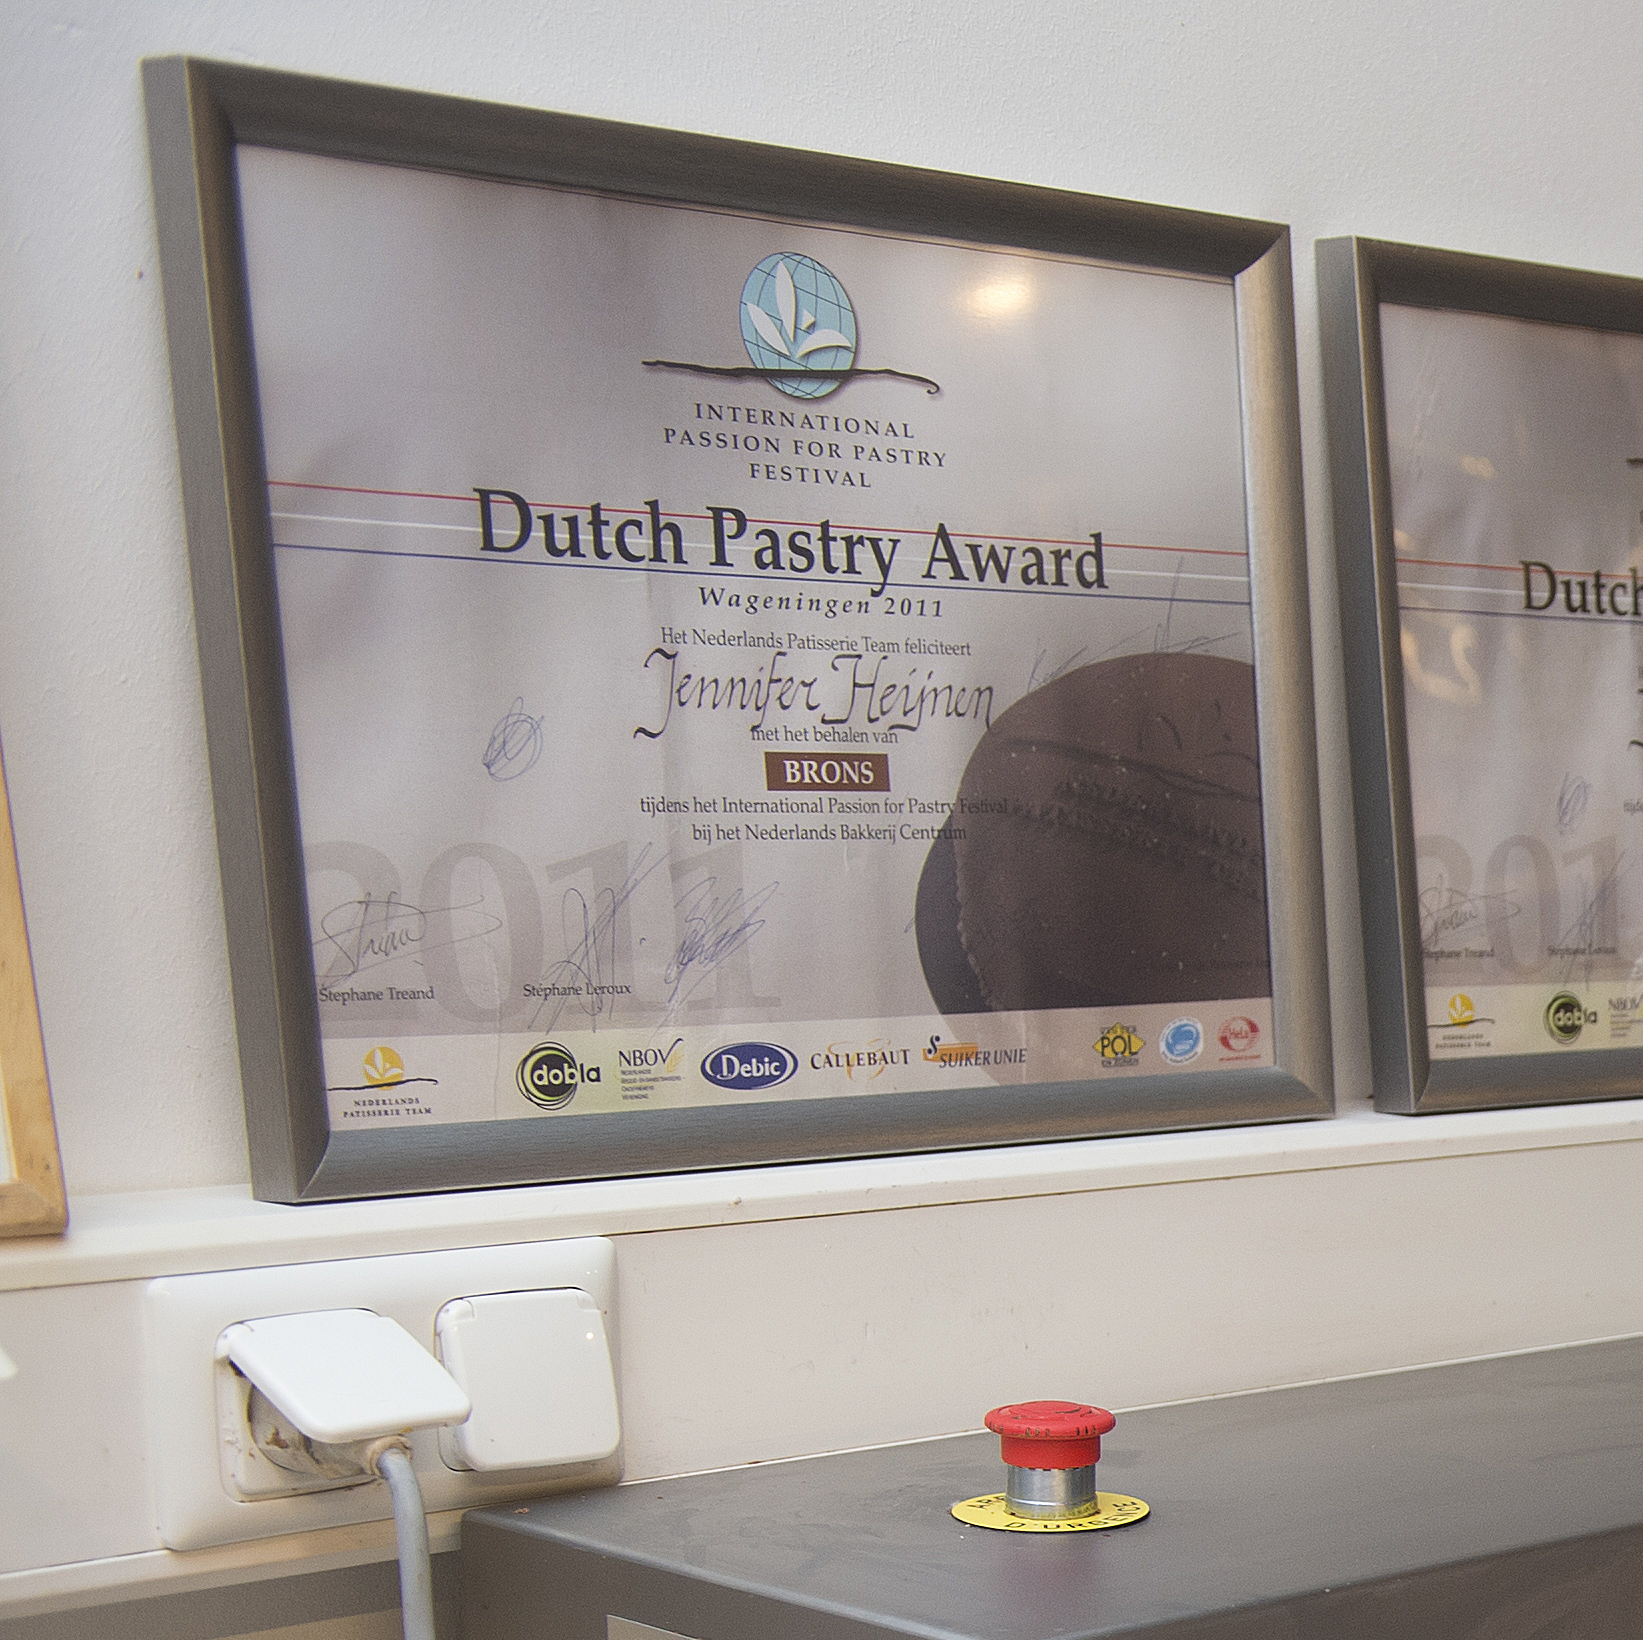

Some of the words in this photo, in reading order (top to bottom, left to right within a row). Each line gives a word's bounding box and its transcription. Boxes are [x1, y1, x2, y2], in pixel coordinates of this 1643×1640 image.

[695, 402, 916, 440] INTERNATIONAL
[664, 427, 783, 455] PASSION
[792, 438, 842, 459] FOR
[853, 444, 948, 469] PASTRY
[749, 462, 873, 488] FESTIVAL
[472, 486, 688, 566] Dutch
[706, 505, 902, 598] Pastry
[922, 523, 1109, 590] Award
[699, 585, 871, 619] Wageningen
[884, 597, 944, 618] 2011
[660, 627, 689, 646] Het
[692, 629, 784, 650] Nederlands
[787, 633, 860, 654] Patisserie
[861, 636, 901, 655] Team
[903, 637, 972, 657] feliciteert
[633, 647, 822, 738] Jennifer
[750, 728, 781, 743] met
[783, 727, 810, 743] het
[812, 727, 869, 745] behalen
[871, 731, 899, 745] van
[784, 760, 875, 785] BRONS
[640, 797, 690, 818] tijdens
[693, 798, 719, 815] het
[722, 797, 824, 816] International
[828, 798, 880, 815] Passion
[883, 798, 905, 815] for
[908, 799, 955, 820] Pastry
[959, 798, 1008, 816] Festival
[692, 823, 713, 845] bij
[716, 824, 742, 842] het
[745, 824, 837, 842] Nederlands
[840, 824, 897, 845] Bakkerij
[900, 824, 967, 842] Centrum
[386, 985, 435, 1001] Treand
[586, 982, 632, 997] Leroux
[618, 1039, 684, 1068] NBOV
[939, 1048, 991, 1069] SUIKER
[991, 1047, 1028, 1067] UNIE
[1100, 1034, 1138, 1057] POL
[716, 1053, 782, 1081] Debic
[810, 1048, 910, 1071] CALLEBAUT
[532, 1059, 602, 1088] dobla
